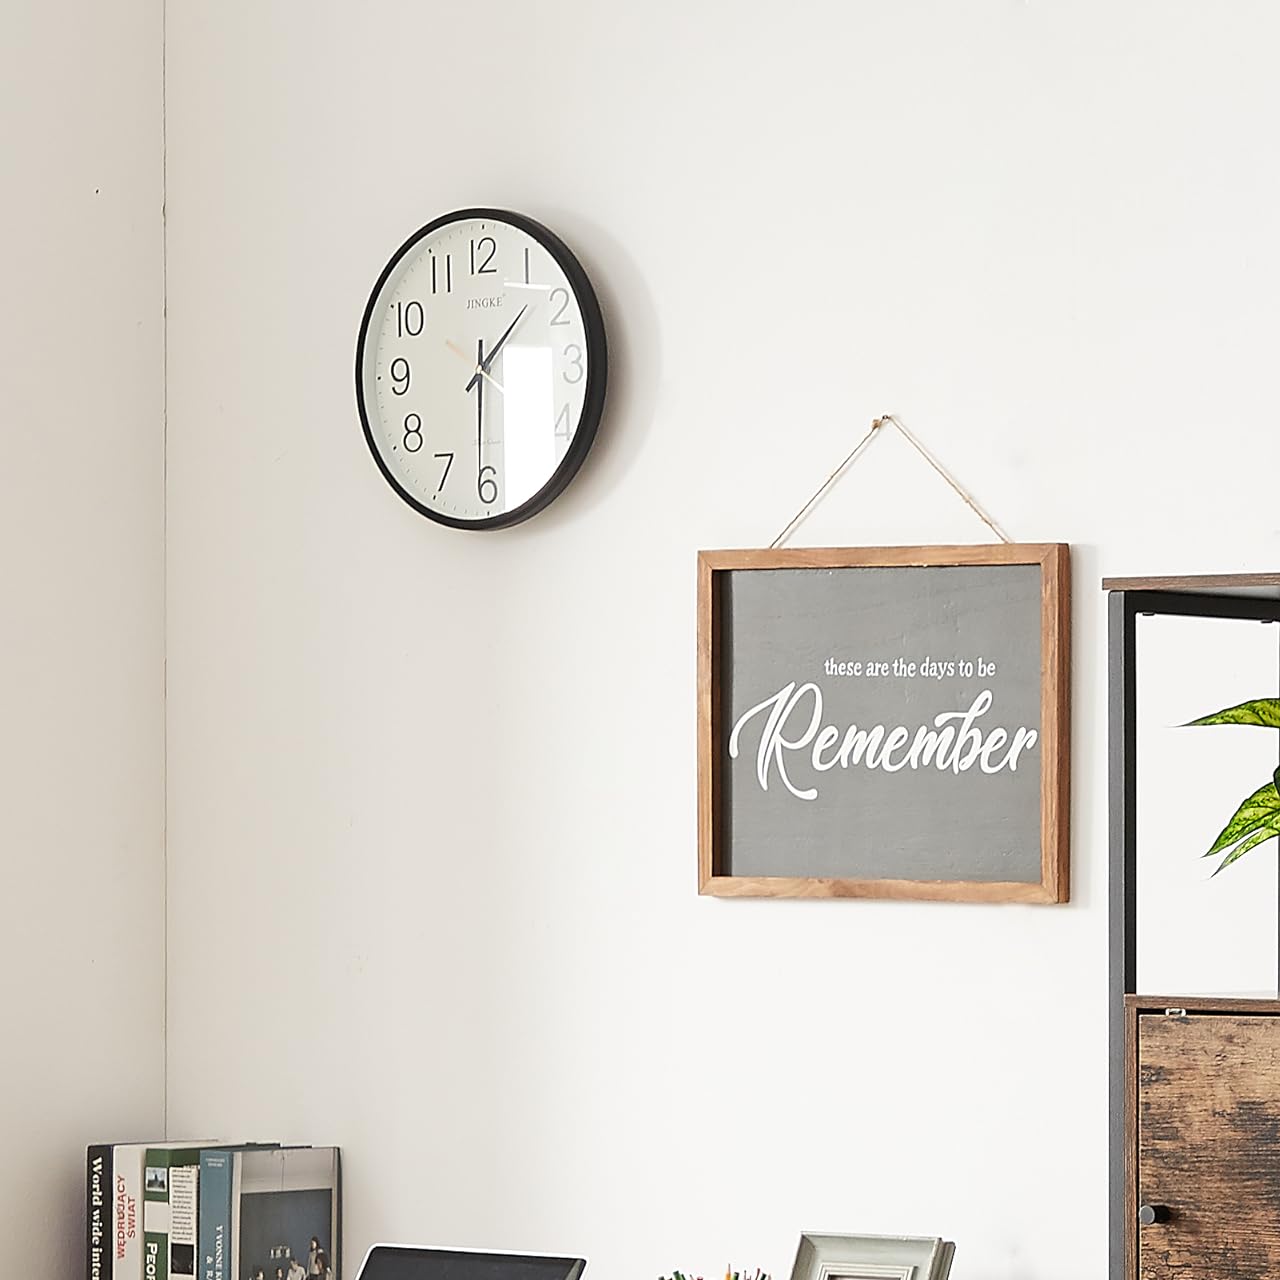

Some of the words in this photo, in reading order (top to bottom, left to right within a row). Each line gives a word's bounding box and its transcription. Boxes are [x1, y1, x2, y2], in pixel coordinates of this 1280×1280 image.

[431, 254, 452, 294] 11
[470, 236, 498, 275] 12
[523, 247, 531, 285] 1
[397, 300, 425, 338] 10
[466, 297, 503, 309] JINGKE
[549, 287, 571, 327] 2
[390, 357, 411, 396] 9
[562, 343, 584, 384] 3
[402, 413, 424, 453] 8
[554, 402, 573, 441] 4
[433, 452, 455, 492] 7
[478, 465, 498, 504] 6
[824, 658, 862, 677] these
[865, 662, 890, 677] are
[892, 657, 916, 677] the
[919, 656, 955, 680] days
[957, 658, 974, 677] to
[977, 657, 996, 677] be
[728, 680, 1039, 801] Remember
[91, 1156, 103, 1207] World
[91, 1209, 103, 1245] wide
[126, 1196, 137, 1239] ŚWIAT
[215, 1225, 224, 1270] YVONNE
